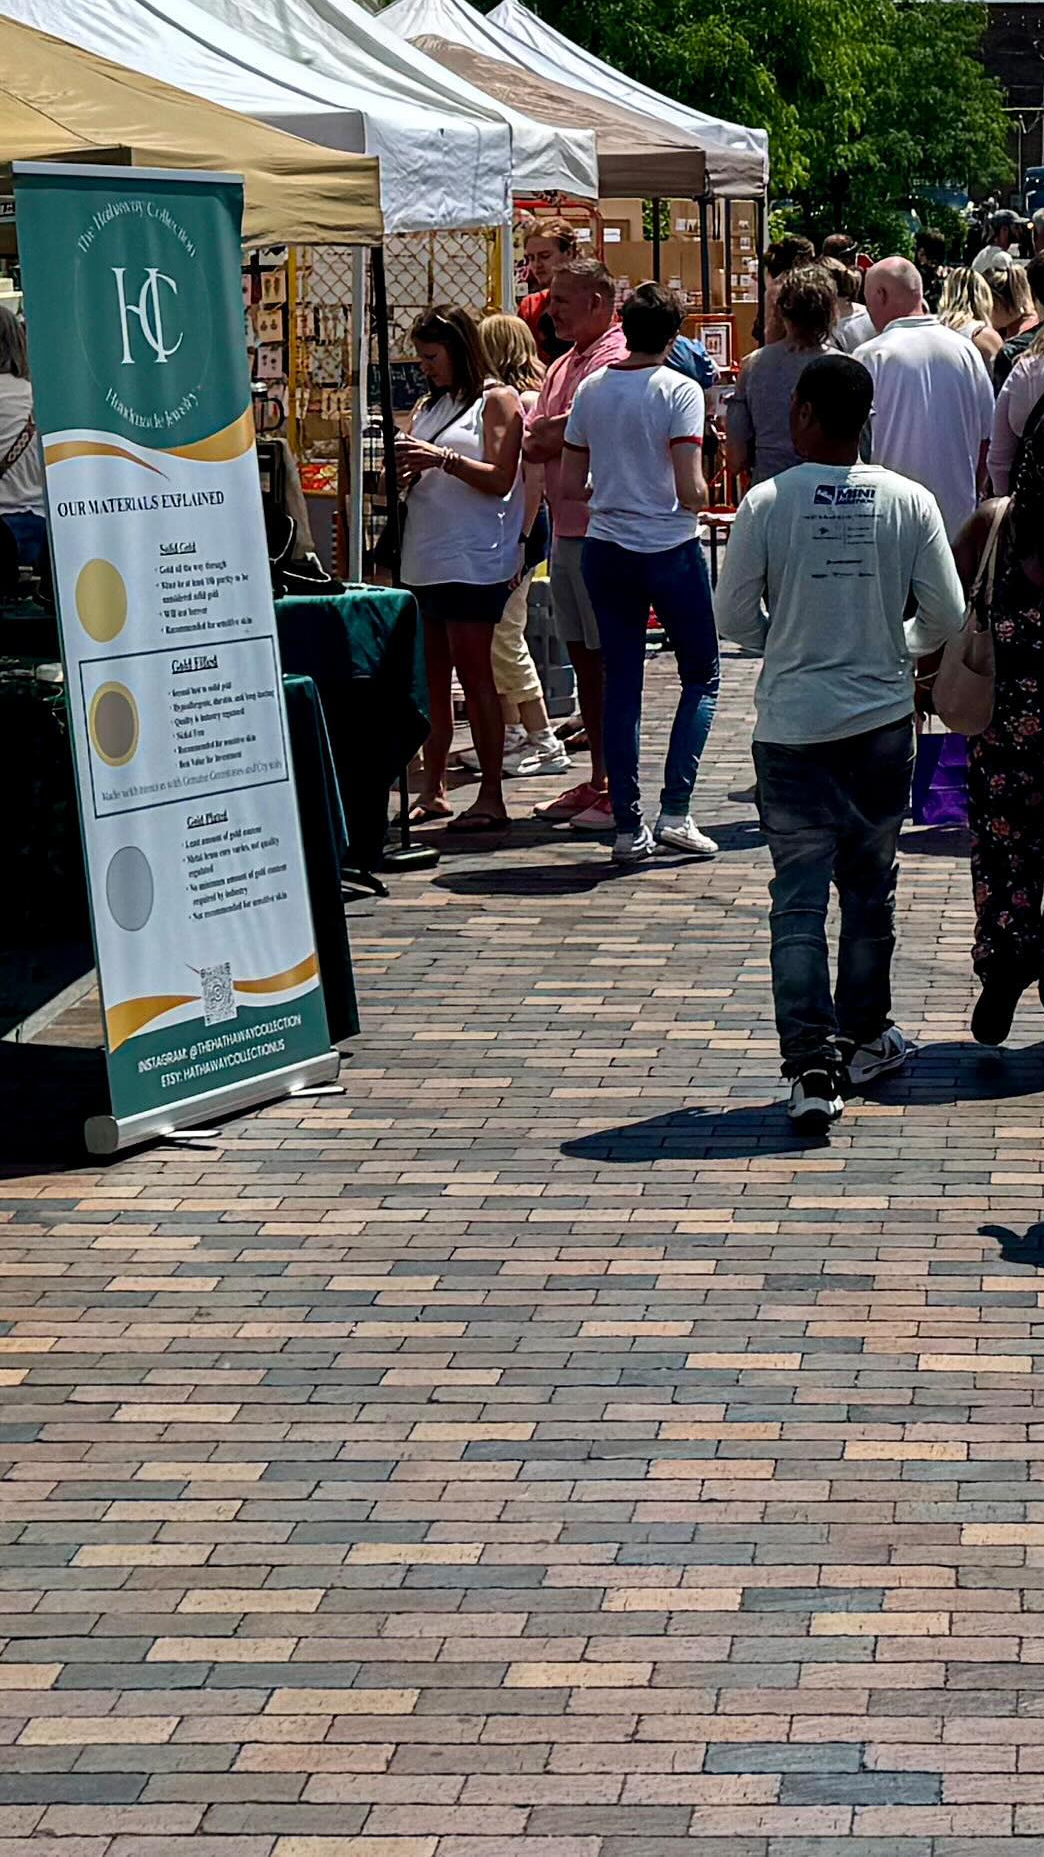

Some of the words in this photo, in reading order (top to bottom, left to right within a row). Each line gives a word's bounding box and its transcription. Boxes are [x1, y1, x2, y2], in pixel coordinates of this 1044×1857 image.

[57, 500, 86, 518] OUR
[88, 494, 159, 515] MATERIALS
[162, 490, 225, 509] EXPLAINED
[138, 1048, 188, 1073] INSTAGRAM:
[189, 1014, 302, 1061] @THEHATHAWAYCOLLECTION
[160, 1071, 184, 1088] ETSY:
